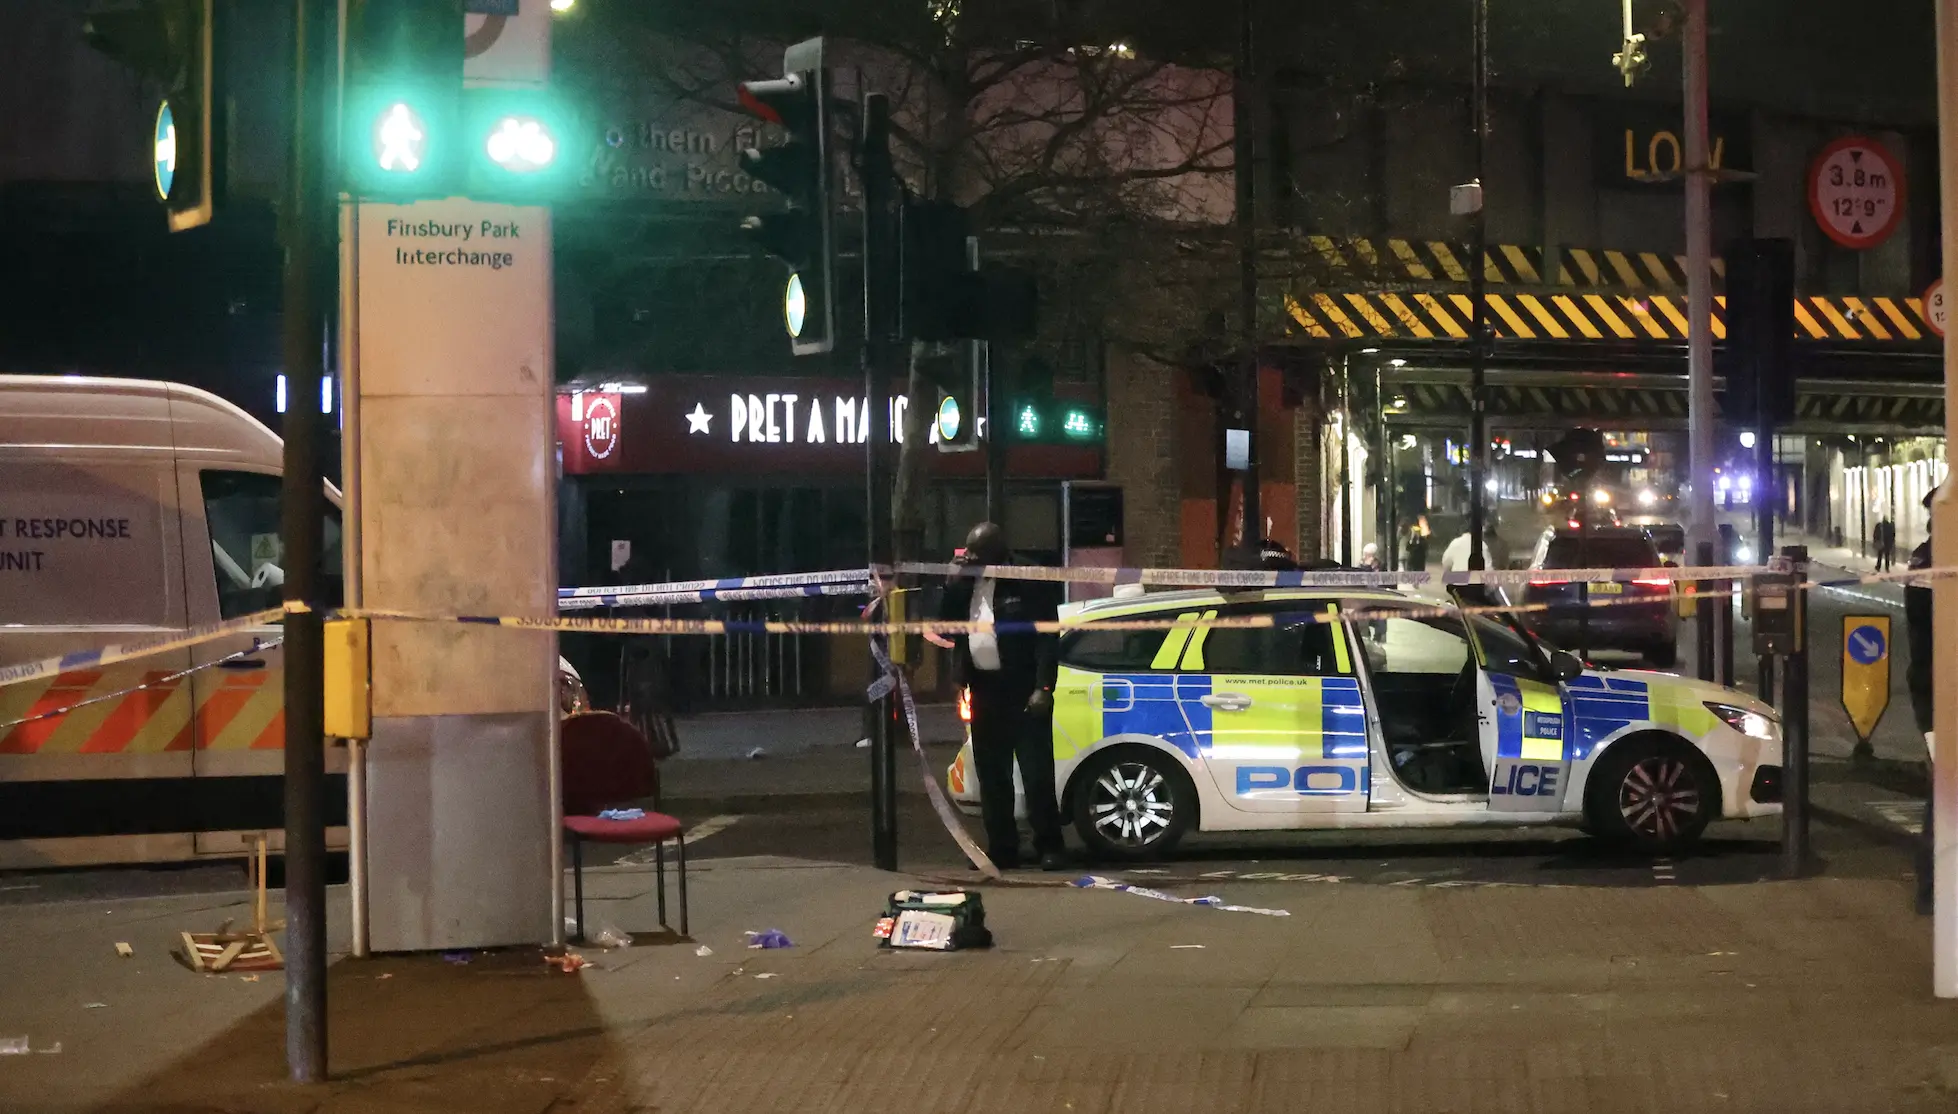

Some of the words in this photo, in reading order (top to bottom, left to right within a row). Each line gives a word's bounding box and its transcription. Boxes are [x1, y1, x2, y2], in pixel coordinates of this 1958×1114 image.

[387, 219, 473, 240] Finsbury
[481, 220, 520, 238] Park
[396, 248, 513, 270] Interchange
[591, 416, 611, 440] PRET
[730, 393, 798, 443] PRET
[807, 398, 826, 444] A
[15, 518, 131, 539] RESPONSE
[1225, 678, 1307, 686] www.met.police.uk
[1236, 766, 1369, 796] PO
